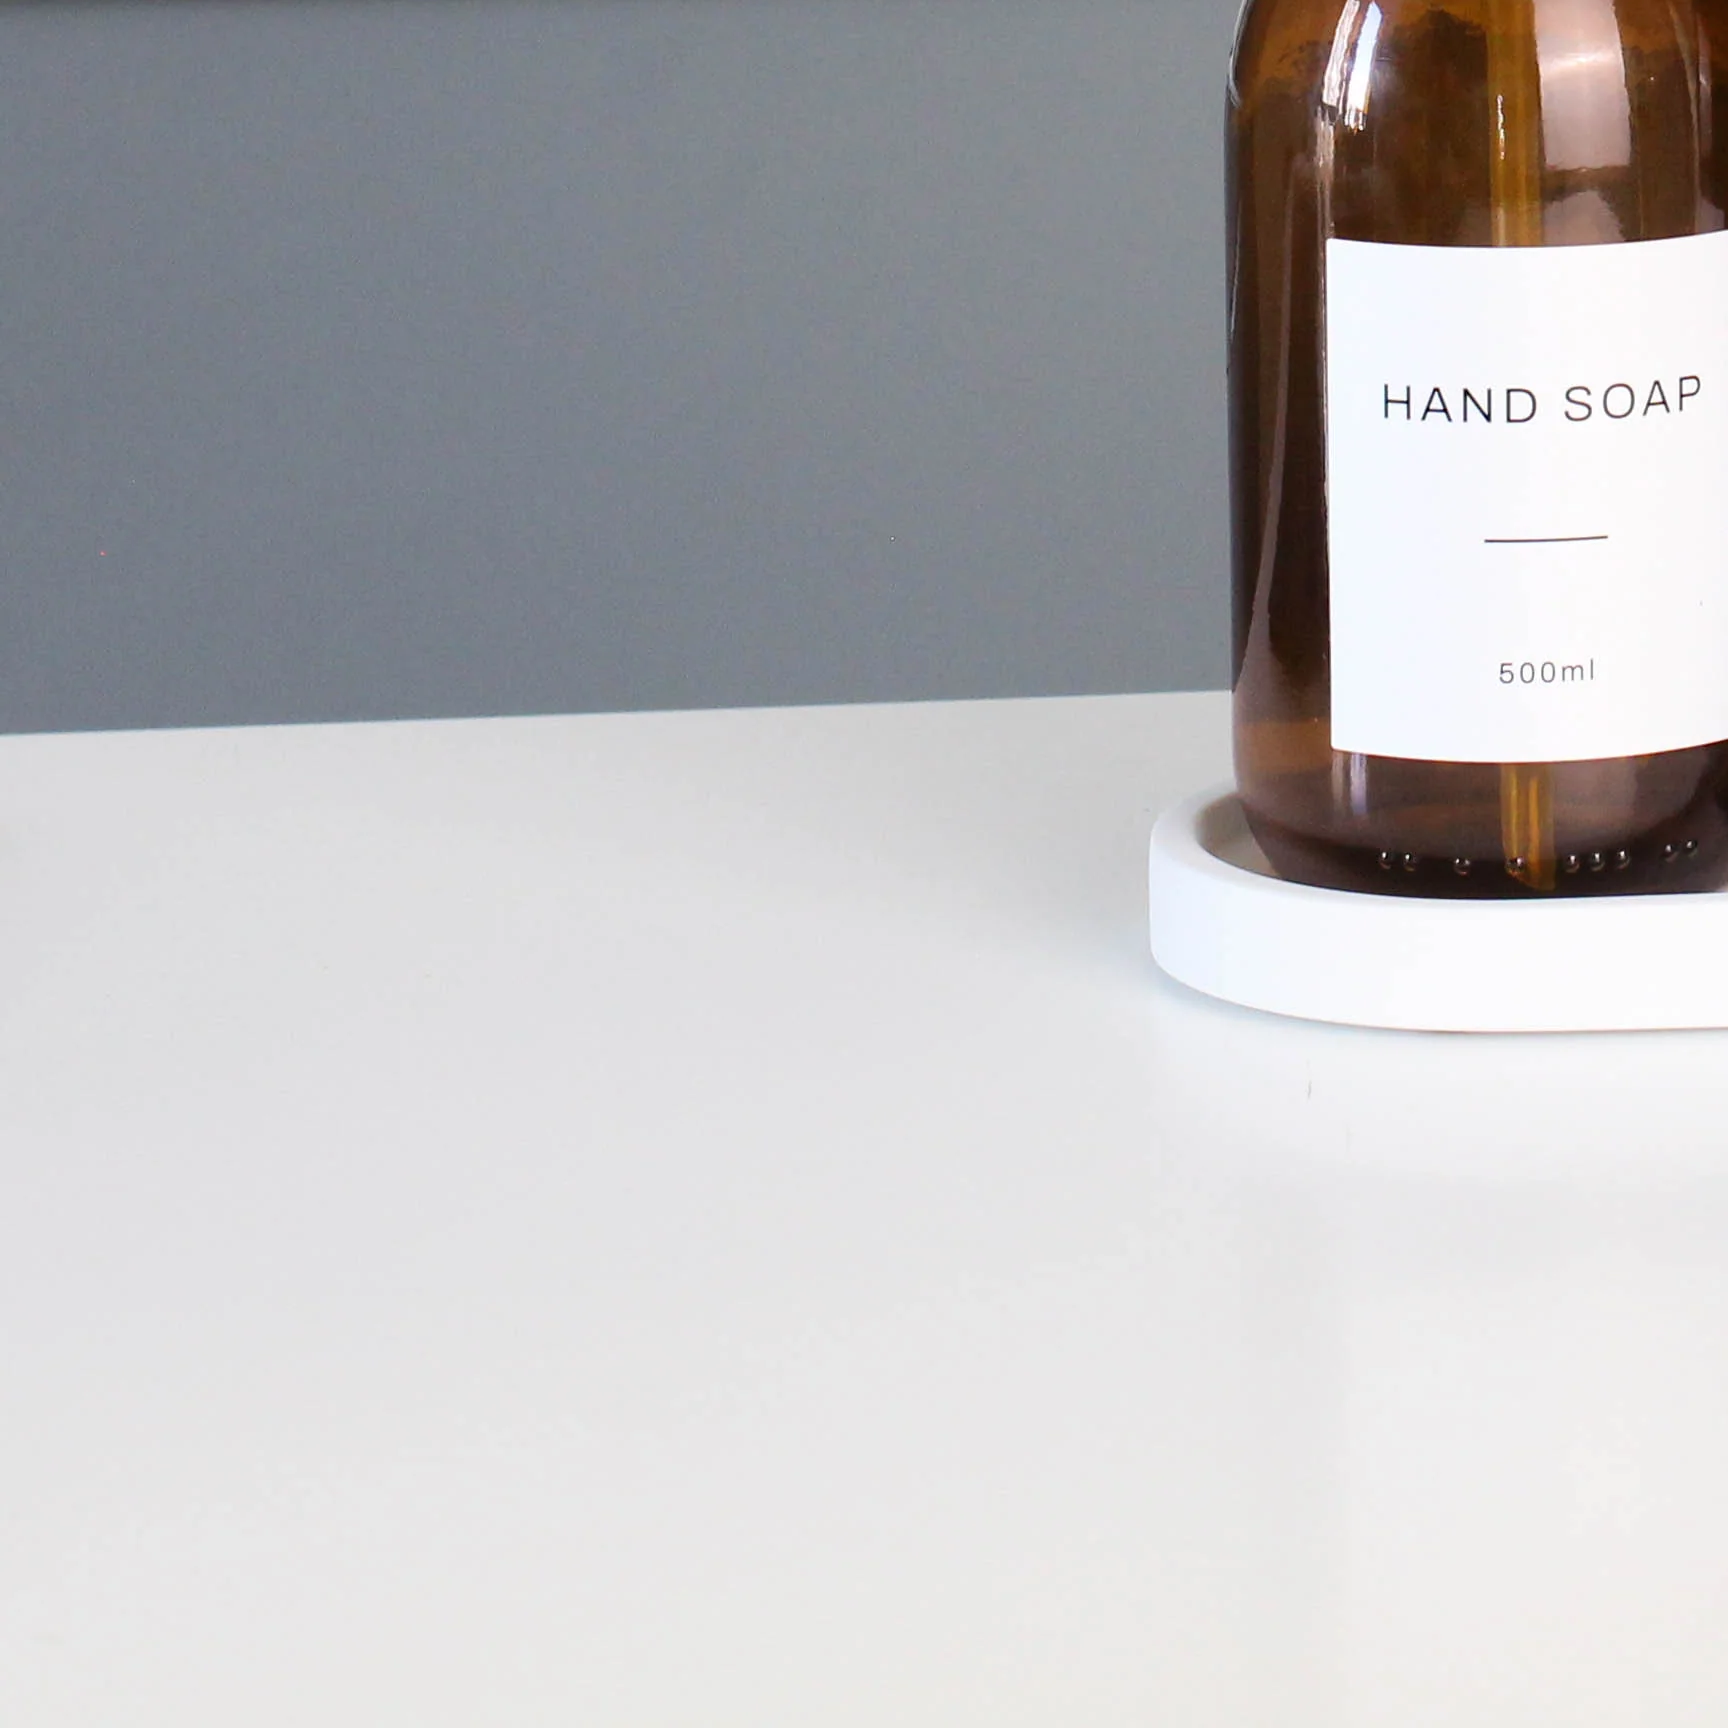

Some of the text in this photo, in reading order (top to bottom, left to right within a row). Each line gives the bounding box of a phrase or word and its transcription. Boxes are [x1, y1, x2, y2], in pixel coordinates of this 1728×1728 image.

[1383, 374, 1702, 424] HAND SOAP
[1499, 659, 1595, 684] 500ml
